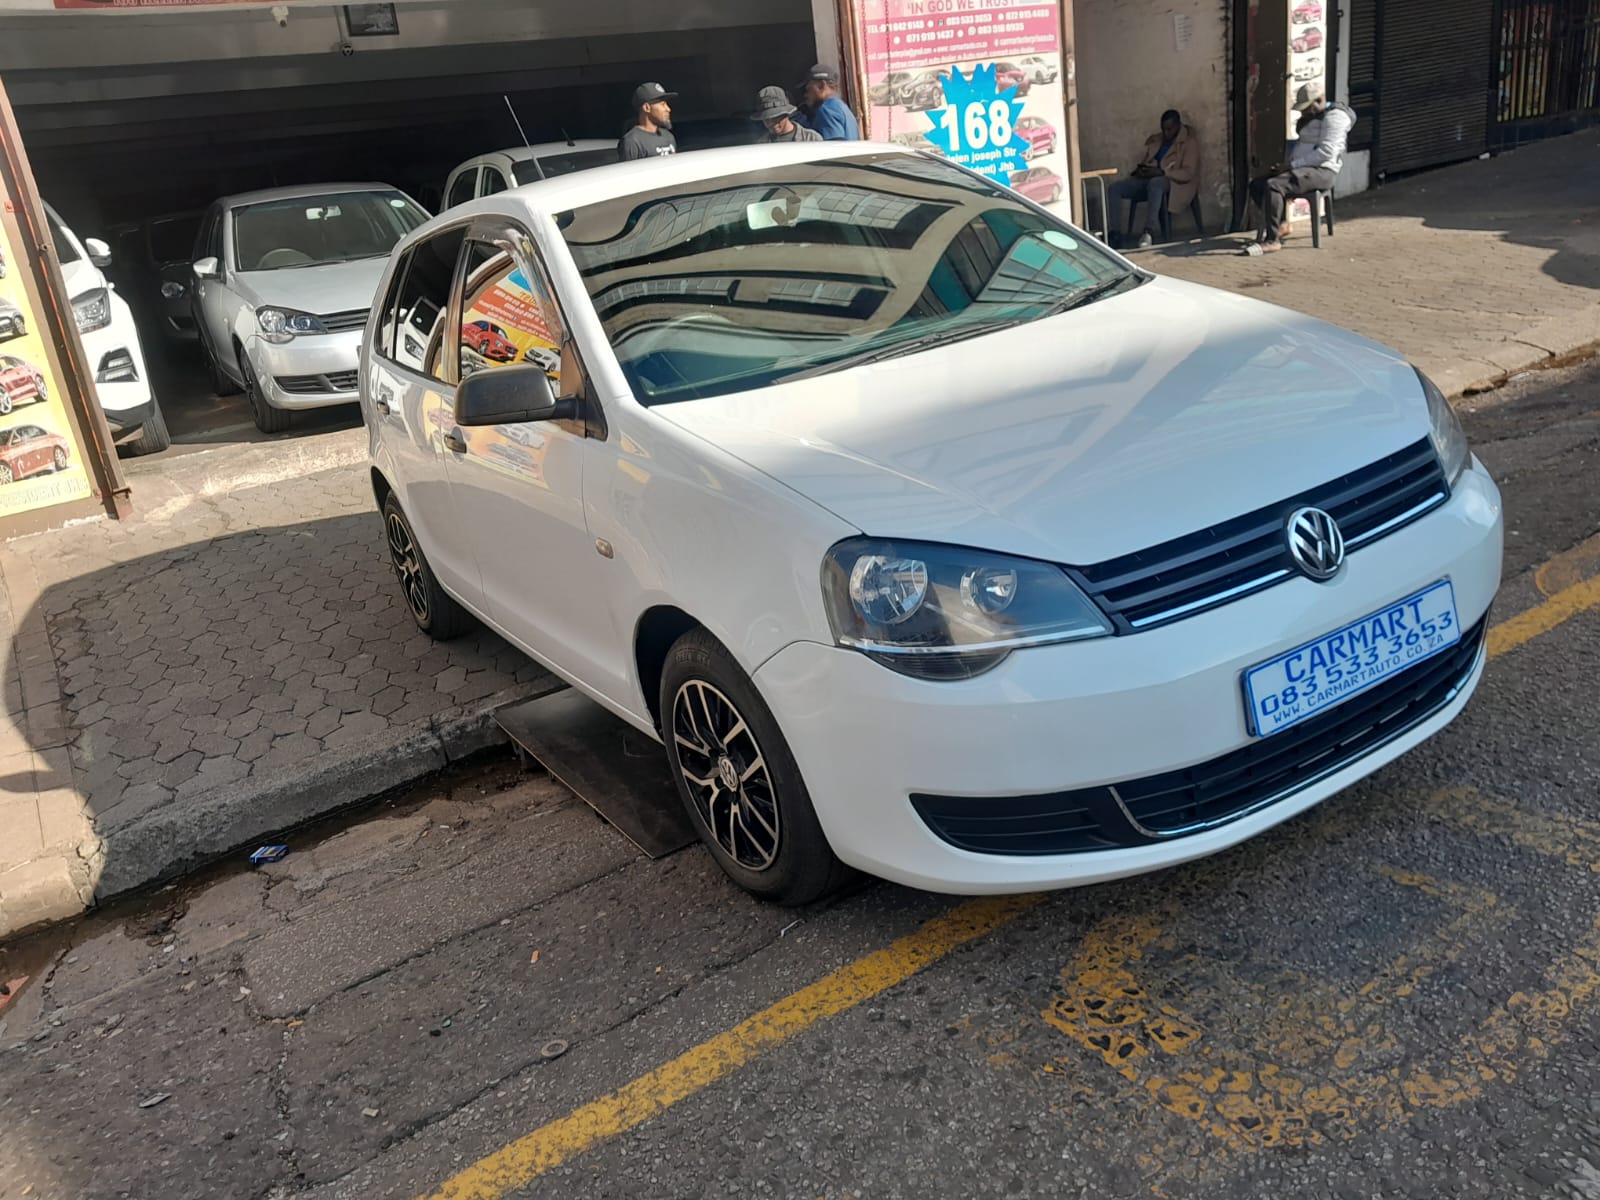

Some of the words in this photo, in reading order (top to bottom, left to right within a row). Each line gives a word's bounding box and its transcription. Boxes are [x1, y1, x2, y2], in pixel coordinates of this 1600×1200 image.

[927, 0, 953, 12] GOD
[957, 0, 975, 10] WE
[941, 99, 1013, 151] 168
[972, 149, 1002, 164] joseph
[1003, 147, 1017, 158] Str
[998, 162, 1015, 172] Jhb
[1284, 597, 1424, 684] CARMART
[1260, 674, 1318, 717] 083
[1325, 646, 1380, 685] 533
[1388, 610, 1453, 656] 3653
